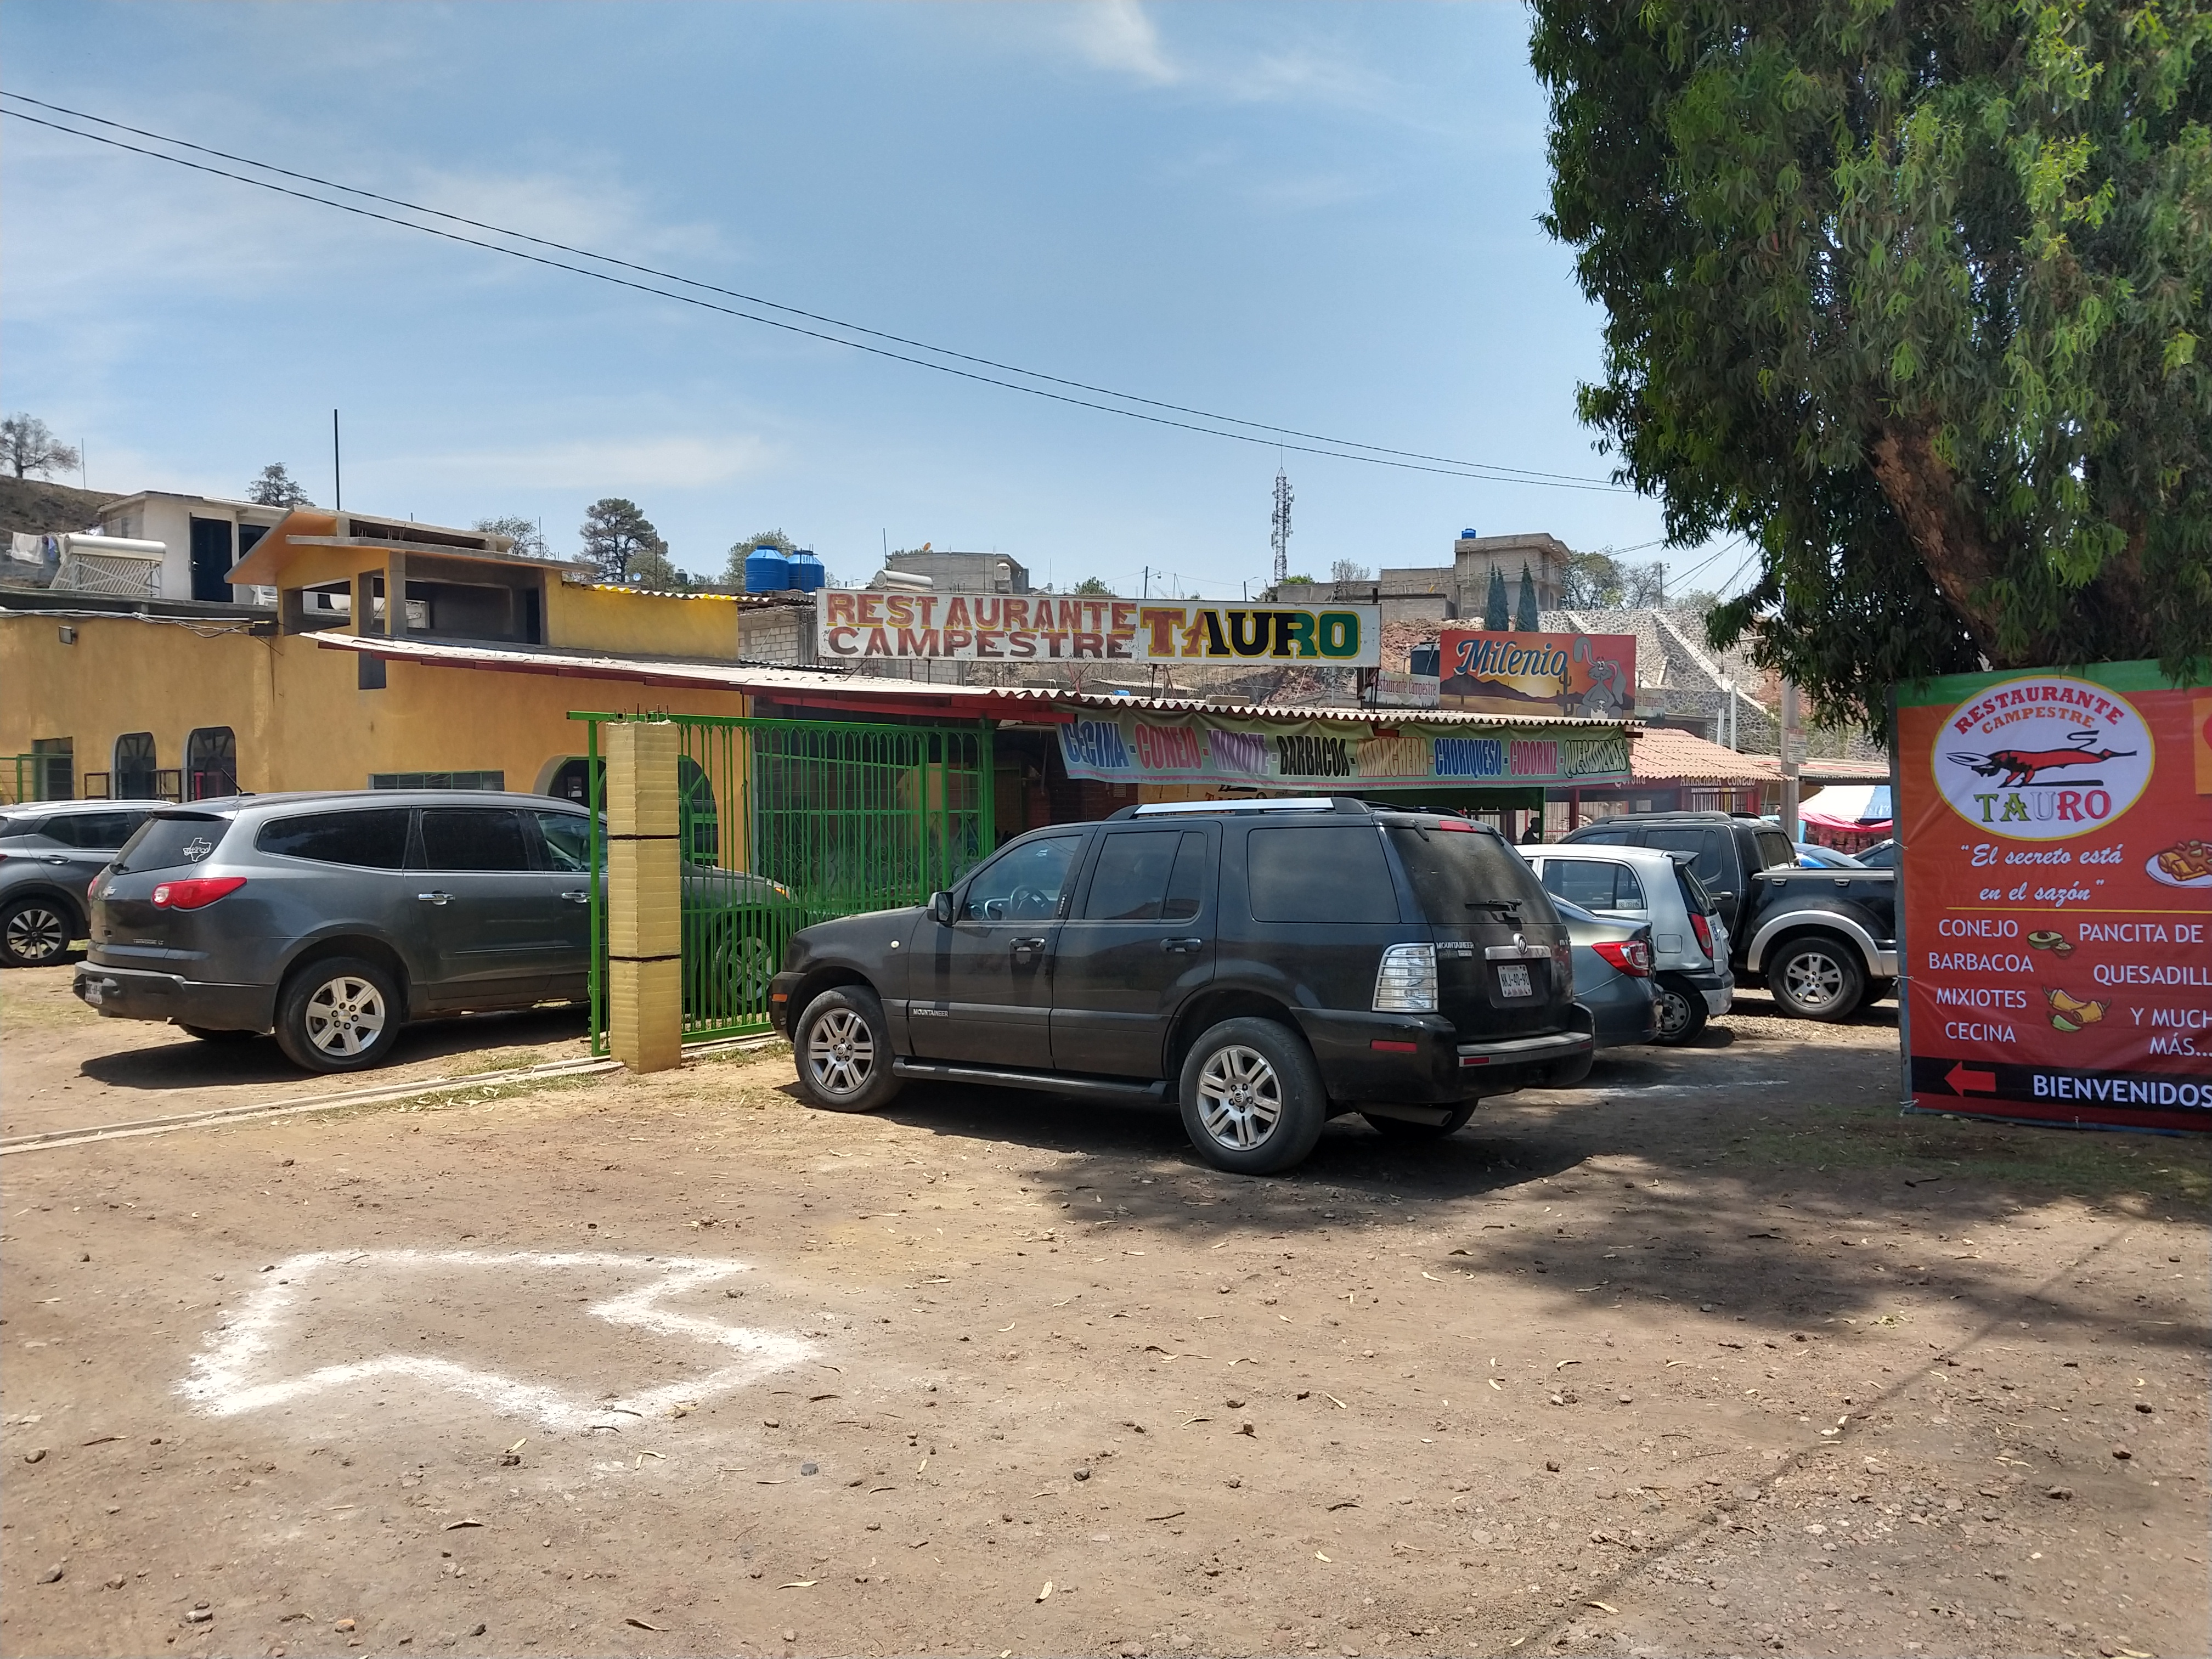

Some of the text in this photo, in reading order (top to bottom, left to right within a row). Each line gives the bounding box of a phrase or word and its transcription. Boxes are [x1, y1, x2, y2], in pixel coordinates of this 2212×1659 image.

[826, 592, 1138, 634] RESTAURANTE
[828, 627, 1135, 658] CAMPESTRE
[1139, 607, 1361, 659] TAURO
[1454, 636, 1568, 677] Milenio
[1408, 678, 1436, 698] Campestre
[1954, 685, 2125, 735] RESTAURANTE
[1982, 706, 2096, 735] CAMPESTRE
[1061, 720, 1130, 768] CECINA
[1135, 723, 1203, 770] CONEJO
[1276, 735, 1351, 777] BARBACOA
[1356, 736, 1429, 777] ARRACHERA
[1434, 737, 1503, 780] CHORIQUESO
[1510, 739, 1558, 776] CODORNIZ
[1564, 737, 1627, 778] QUESADILLAS
[1973, 790, 2112, 822] TAURO
[2005, 848, 2072, 865] secreto
[2079, 843, 2124, 865] está
[1979, 887, 2001, 900] en
[2008, 881, 2028, 900] el
[1938, 919, 2019, 938] CONEJO
[2079, 923, 2204, 943] PANCITA DE
[1928, 952, 2034, 973] BARBACOA
[1936, 988, 2027, 1008] MIXIOTES
[913, 1008, 949, 1017] MOUNTAINEER
[2130, 1007, 2145, 1026] Y
[1945, 1022, 2017, 1043] CECINA
[2033, 1074, 2212, 1108] BIENVENIDOS
